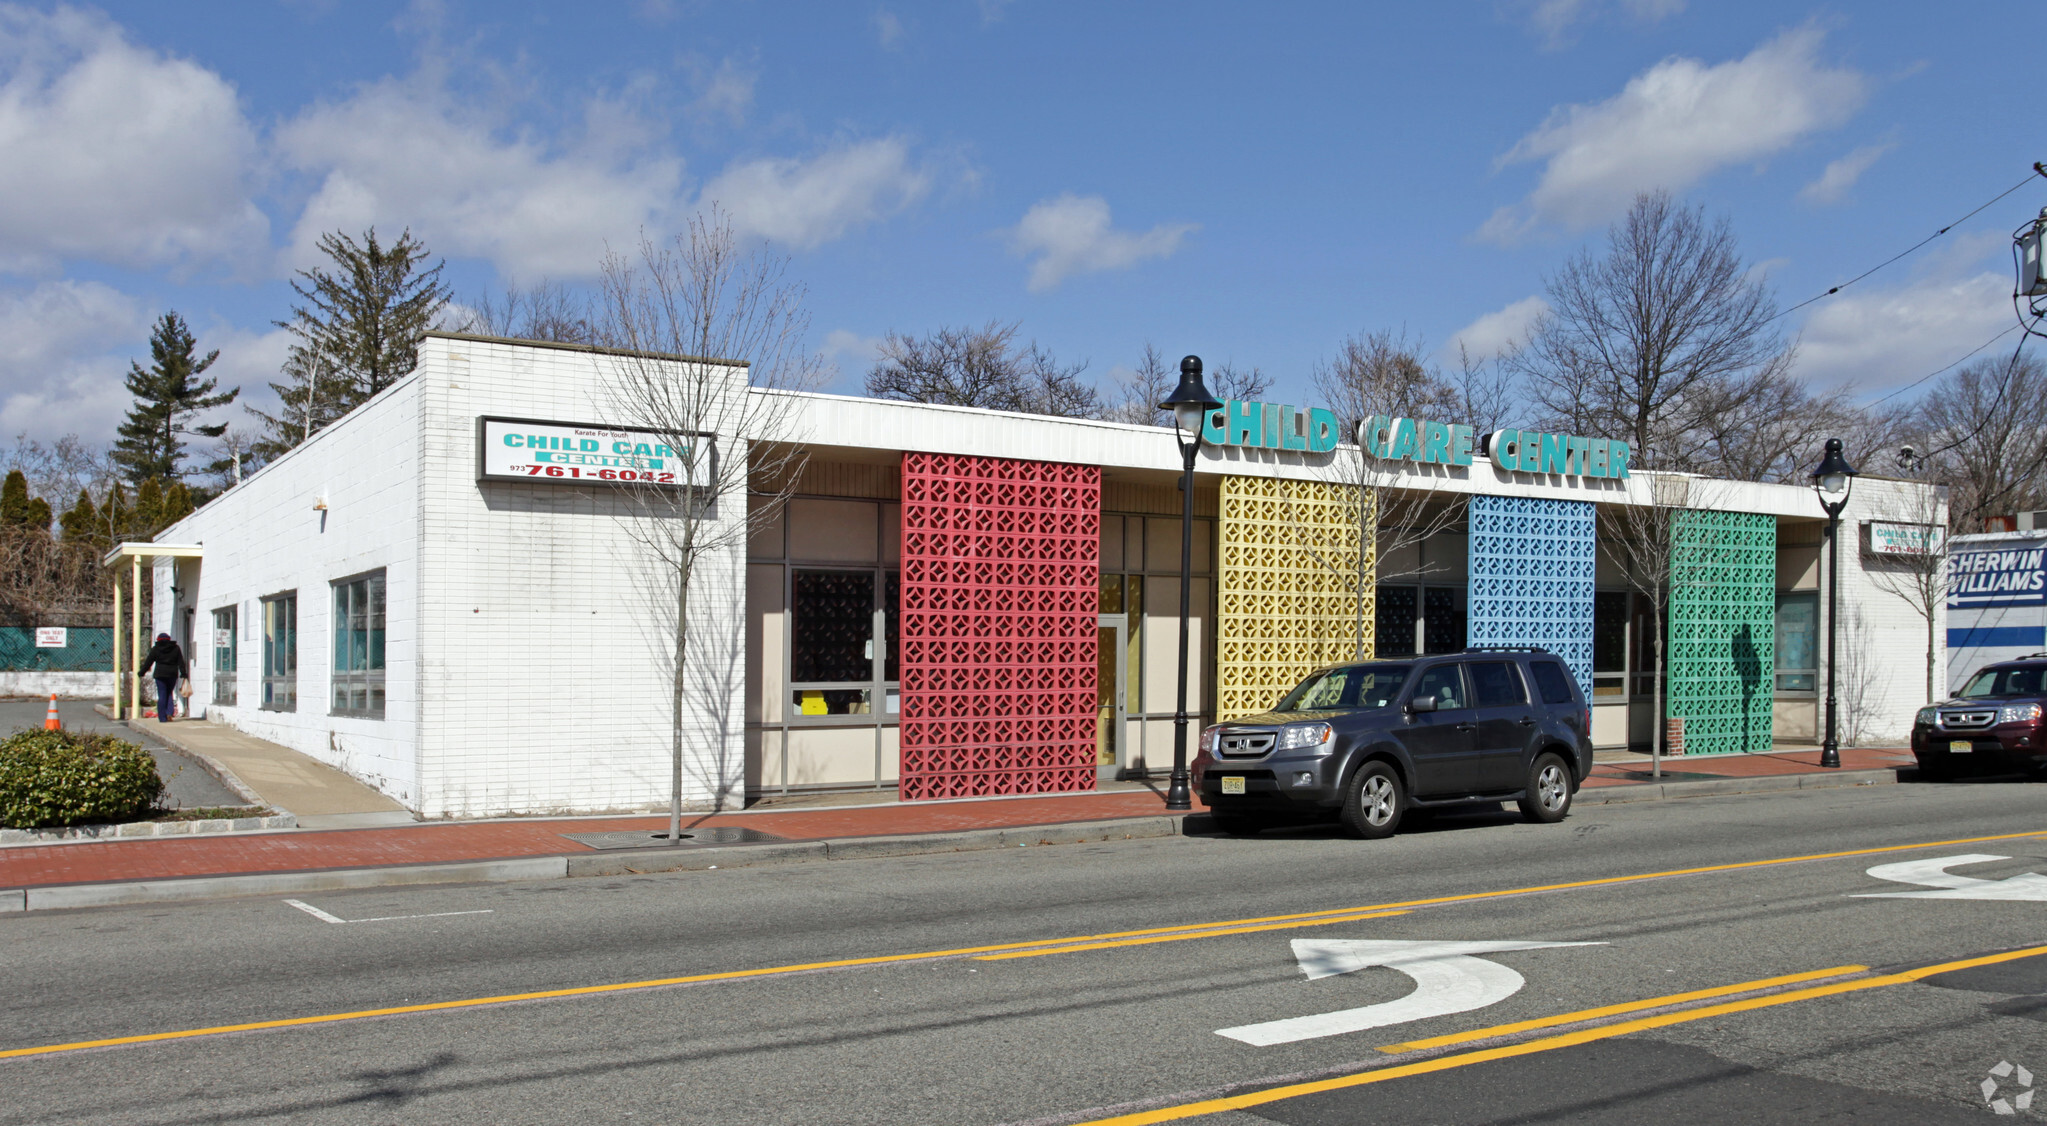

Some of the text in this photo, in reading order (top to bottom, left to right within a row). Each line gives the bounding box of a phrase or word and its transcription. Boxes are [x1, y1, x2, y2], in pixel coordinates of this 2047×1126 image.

[503, 433, 600, 453] CHILD
[574, 429, 629, 439] Karate For Youth
[1202, 397, 1631, 480] CHILD CARE CENTER
[550, 453, 651, 469] CENTER
[526, 464, 675, 484] 761-6042
[1911, 531, 1937, 541] CAE
[1947, 550, 2044, 574] SHERWIN
[1947, 570, 2046, 594] WILLIAMS
